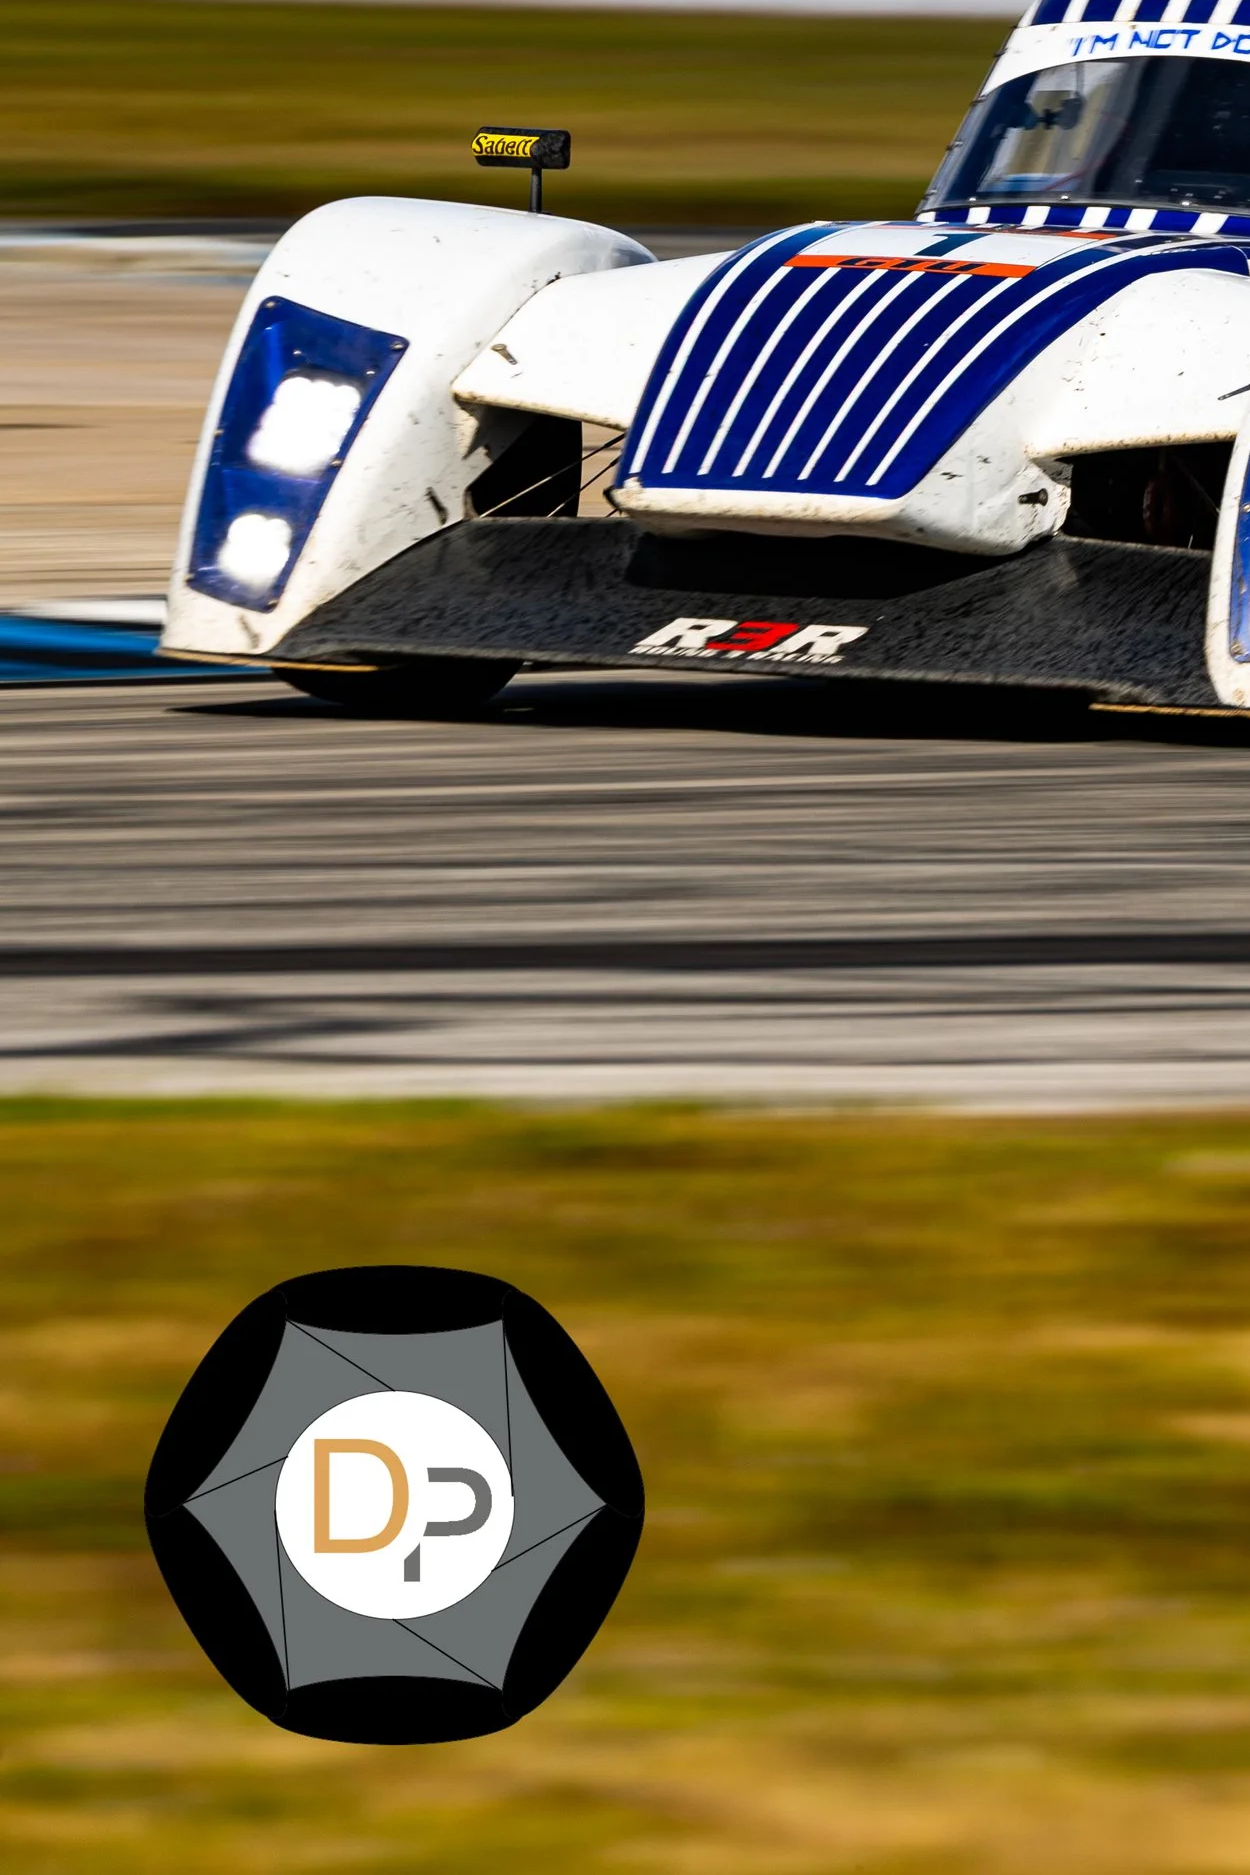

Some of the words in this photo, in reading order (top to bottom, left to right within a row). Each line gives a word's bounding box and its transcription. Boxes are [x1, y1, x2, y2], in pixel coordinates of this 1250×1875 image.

[1128, 29, 1202, 50] NOT
[472, 134, 533, 157] Sabelt
[913, 232, 991, 257] 1
[836, 257, 989, 272] GTU
[634, 617, 870, 655] R3R
